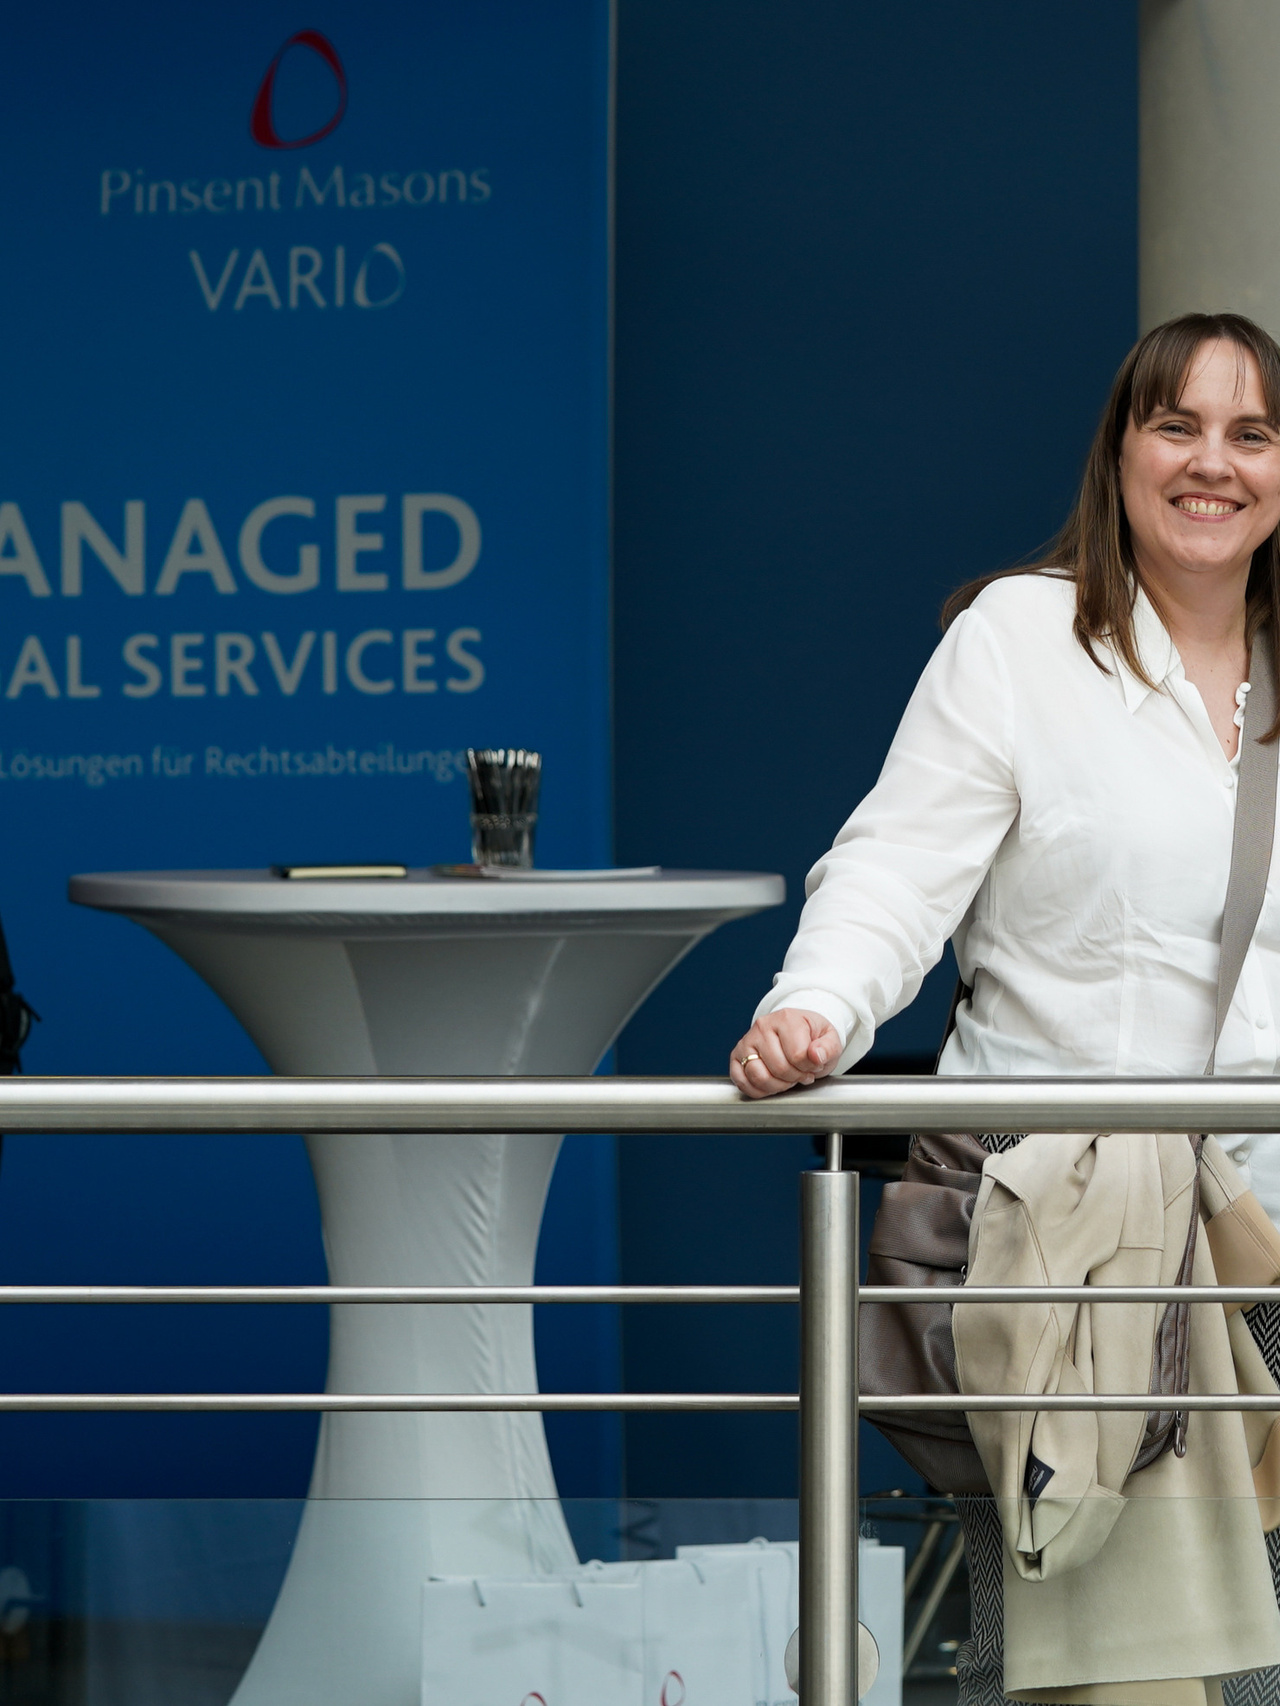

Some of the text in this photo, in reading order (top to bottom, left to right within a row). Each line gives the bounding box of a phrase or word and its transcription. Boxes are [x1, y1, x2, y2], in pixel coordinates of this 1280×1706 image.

[100, 163, 492, 216] Pinsent Masons
[188, 241, 406, 312] VARIO
[0, 492, 483, 598] ANAGED
[6, 627, 486, 700] AL SERVICES
[151, 743, 194, 778] für
